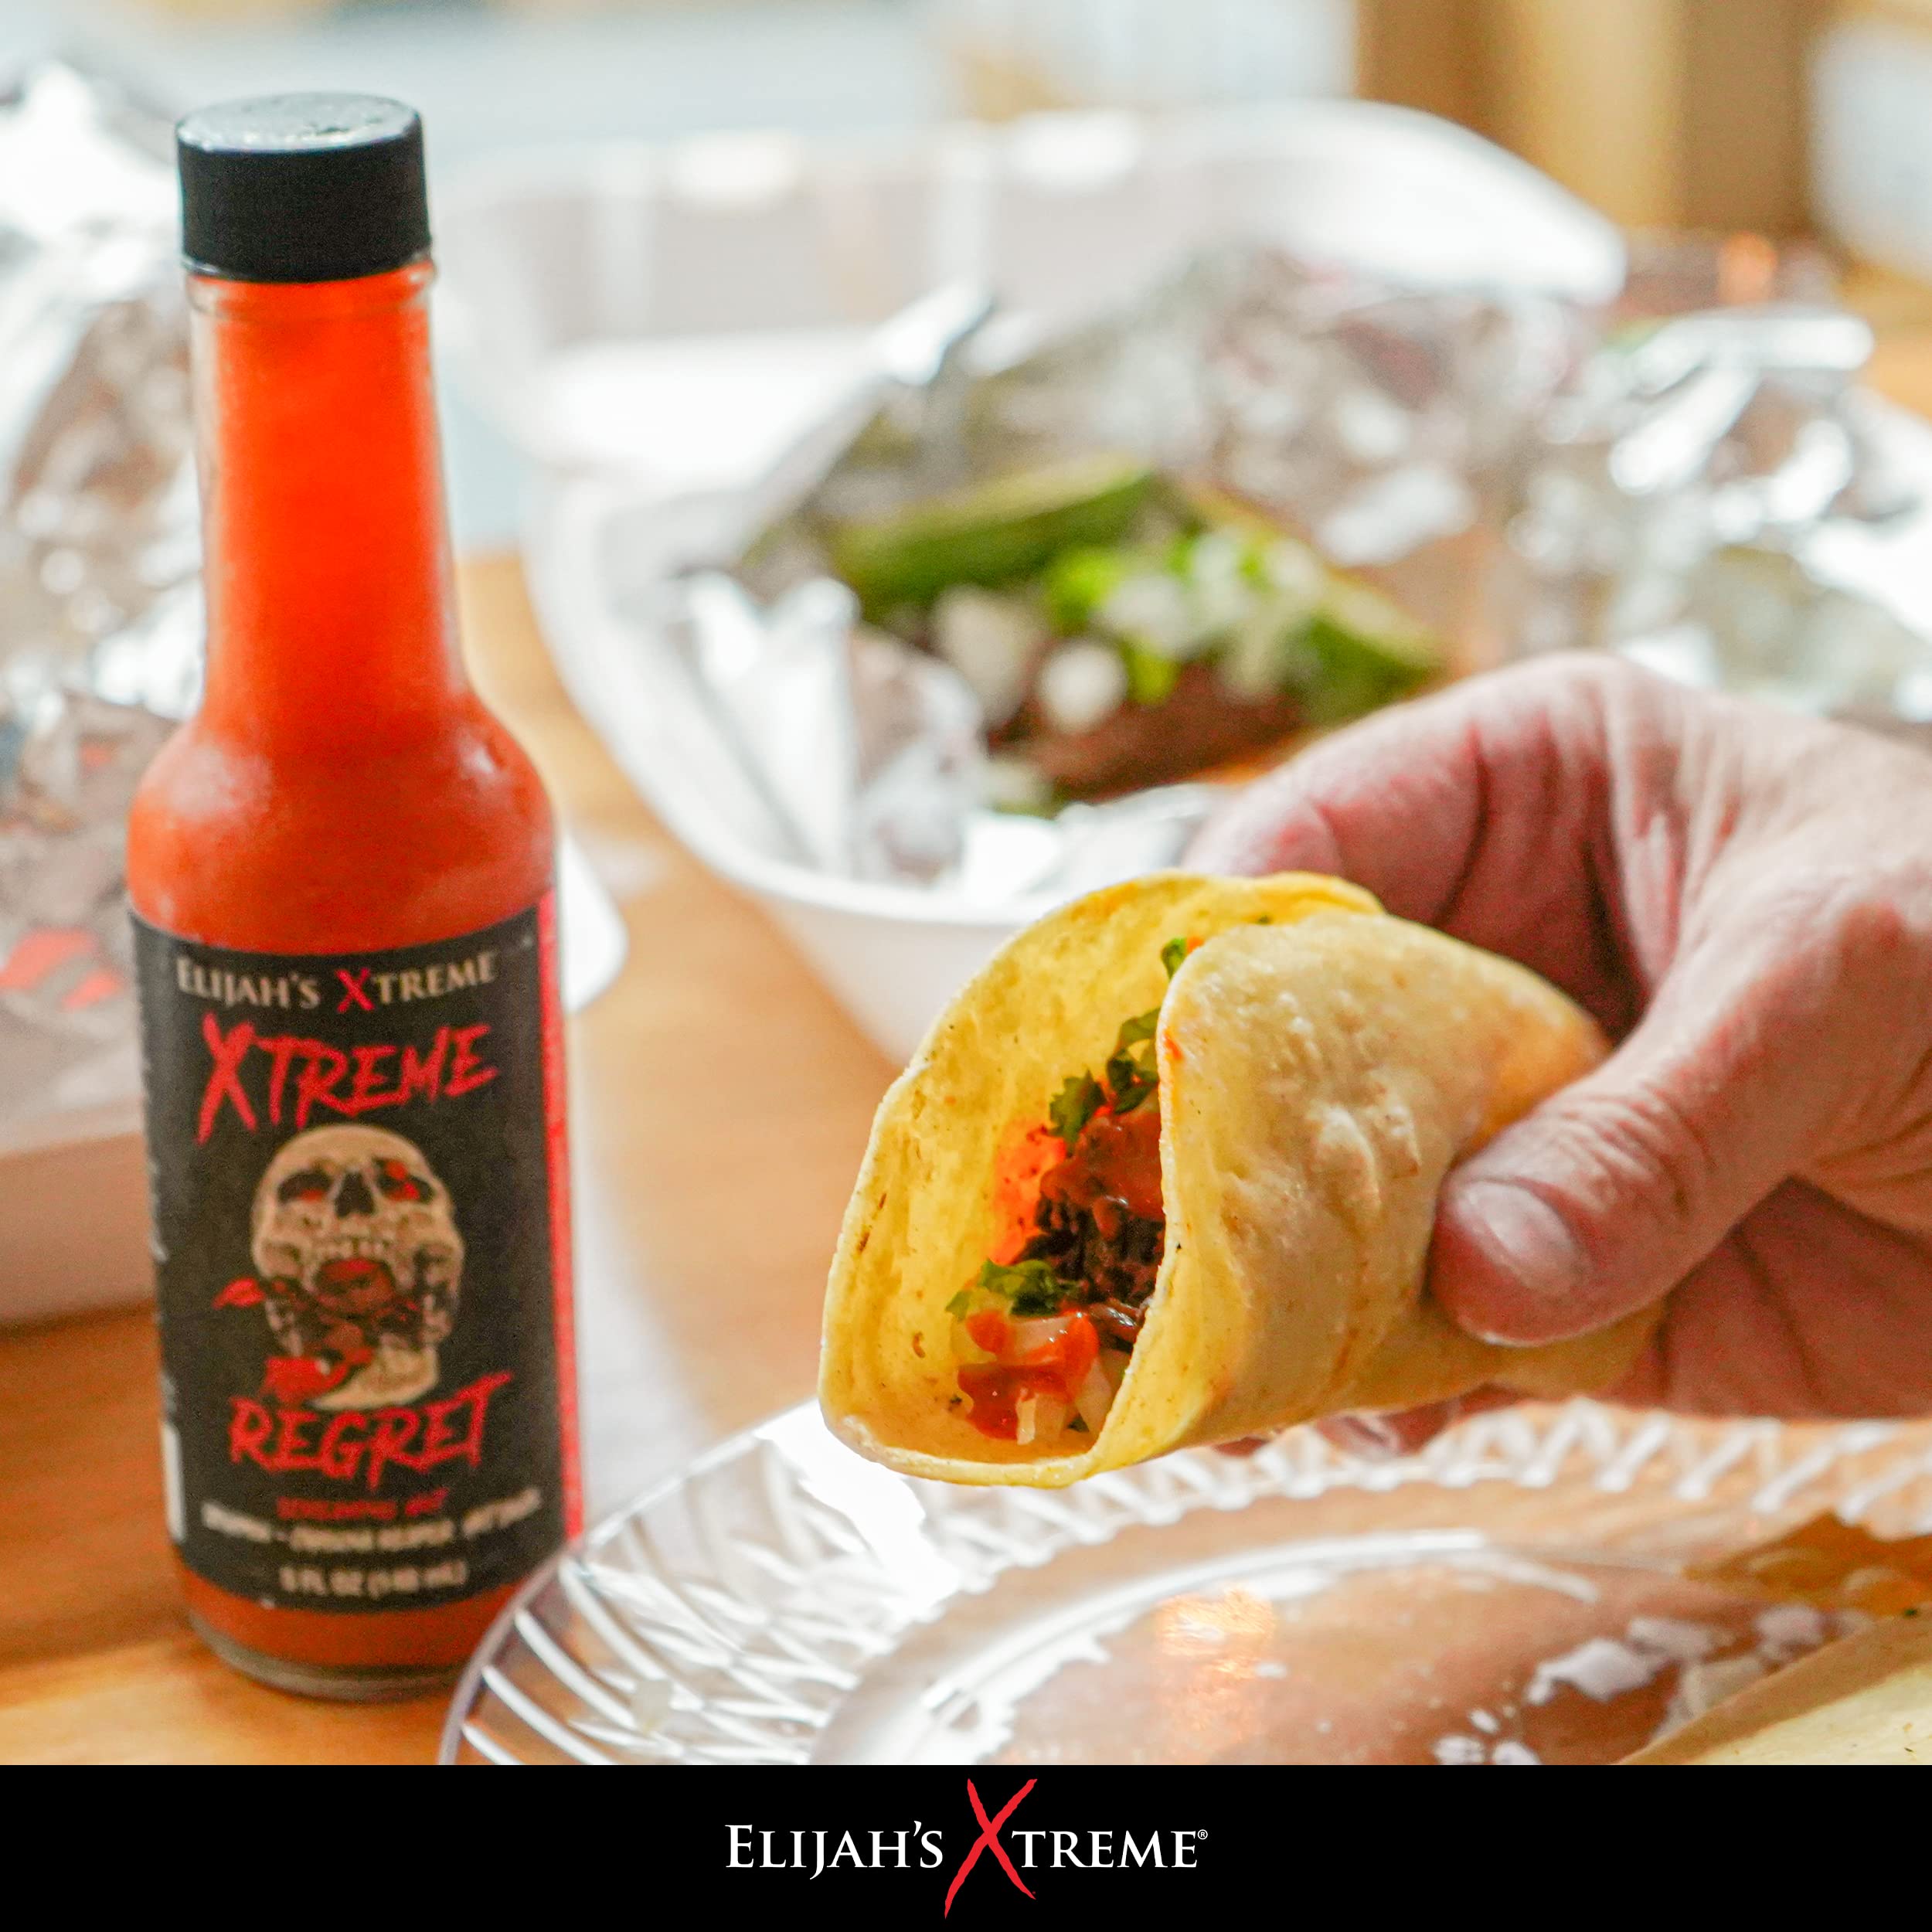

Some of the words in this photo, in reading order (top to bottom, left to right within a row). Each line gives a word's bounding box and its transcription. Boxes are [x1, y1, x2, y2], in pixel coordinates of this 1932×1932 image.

[176, 956, 321, 1009] ELIJAH'S
[335, 951, 498, 1013] XTREME
[198, 1011, 499, 1147] XTREME
[228, 1371, 513, 1492] REGRET
